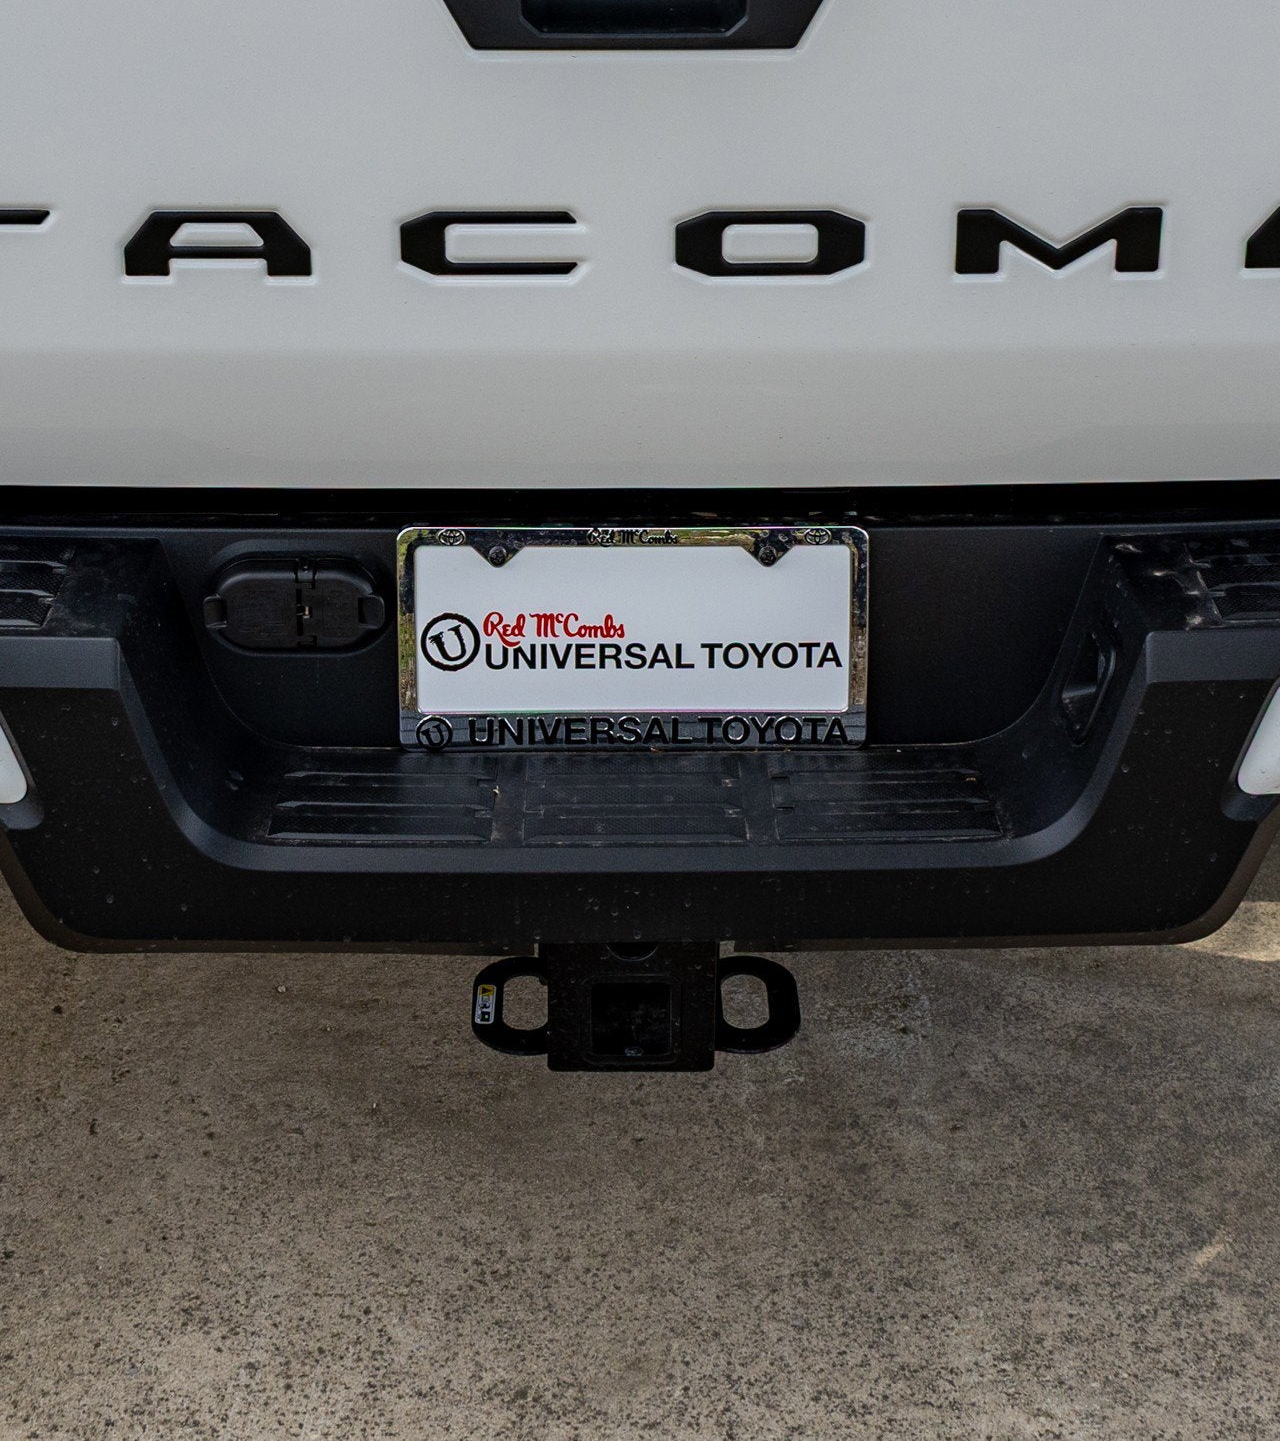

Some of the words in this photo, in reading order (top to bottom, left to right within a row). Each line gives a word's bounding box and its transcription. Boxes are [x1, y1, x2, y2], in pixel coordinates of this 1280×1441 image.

[587, 527, 616, 547] Red
[483, 611, 526, 647] Red
[529, 612, 625, 639] McCombs
[485, 642, 694, 670] UNIVERSAL
[700, 642, 843, 669] TOYOTA
[468, 716, 692, 746] UNIVERSAL
[700, 716, 849, 746] TOYOTA
